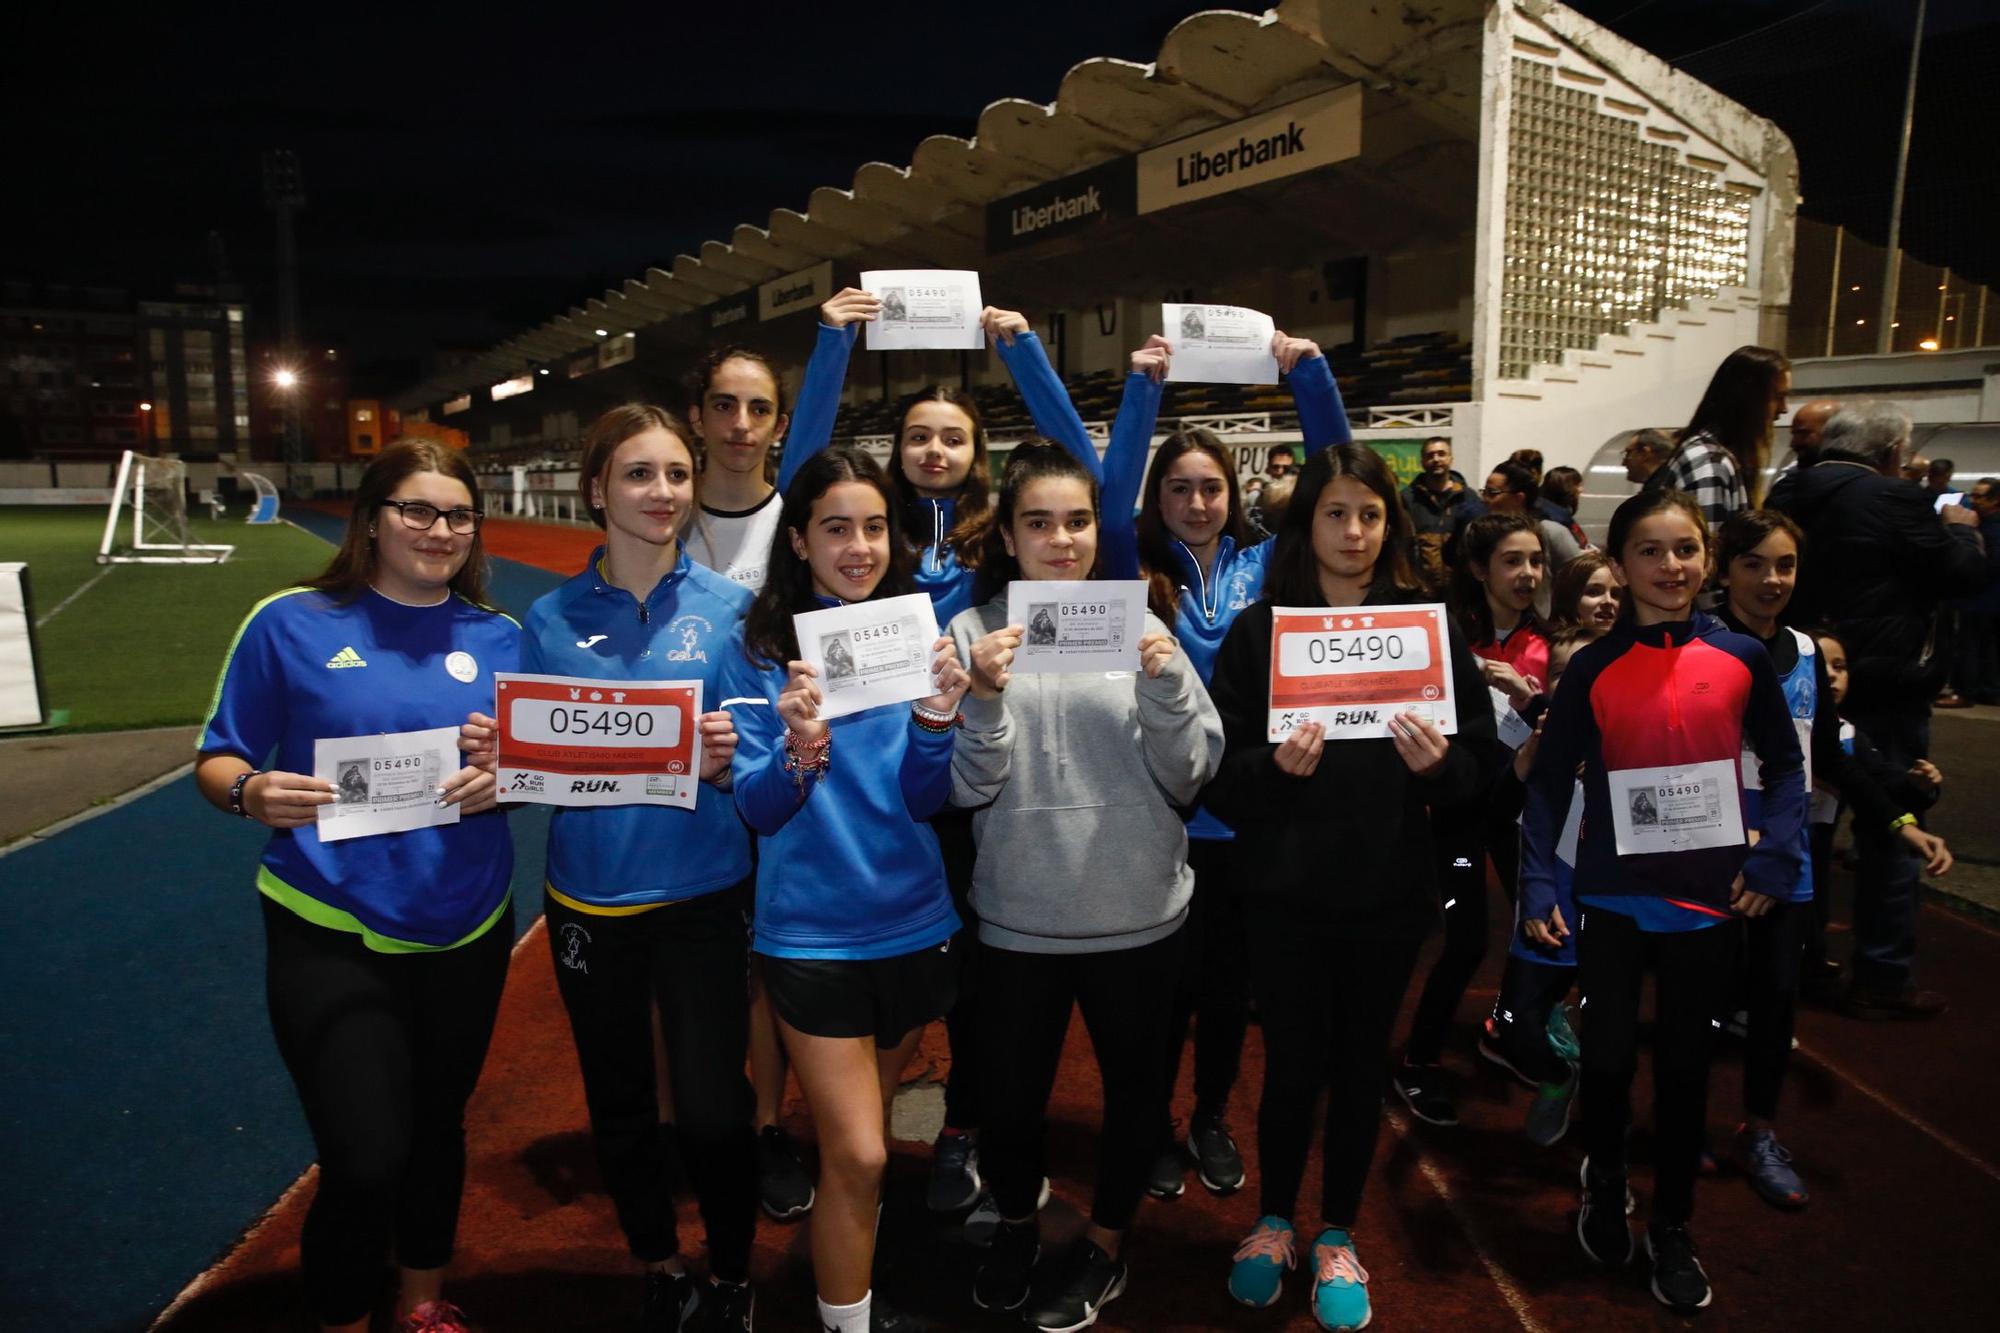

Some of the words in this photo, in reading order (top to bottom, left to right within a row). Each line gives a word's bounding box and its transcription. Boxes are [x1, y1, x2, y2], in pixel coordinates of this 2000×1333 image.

[1177, 122, 1305, 188] Liberbank
[1013, 186, 1101, 236] Liberbank
[1061, 605, 1106, 616] 05490
[854, 623, 899, 642] 05490
[1309, 635, 1403, 664] 05490
[326, 659, 368, 669] adidas
[550, 707, 654, 737] 05490
[374, 757, 421, 771] 05490
[1659, 785, 1701, 797] 05490
